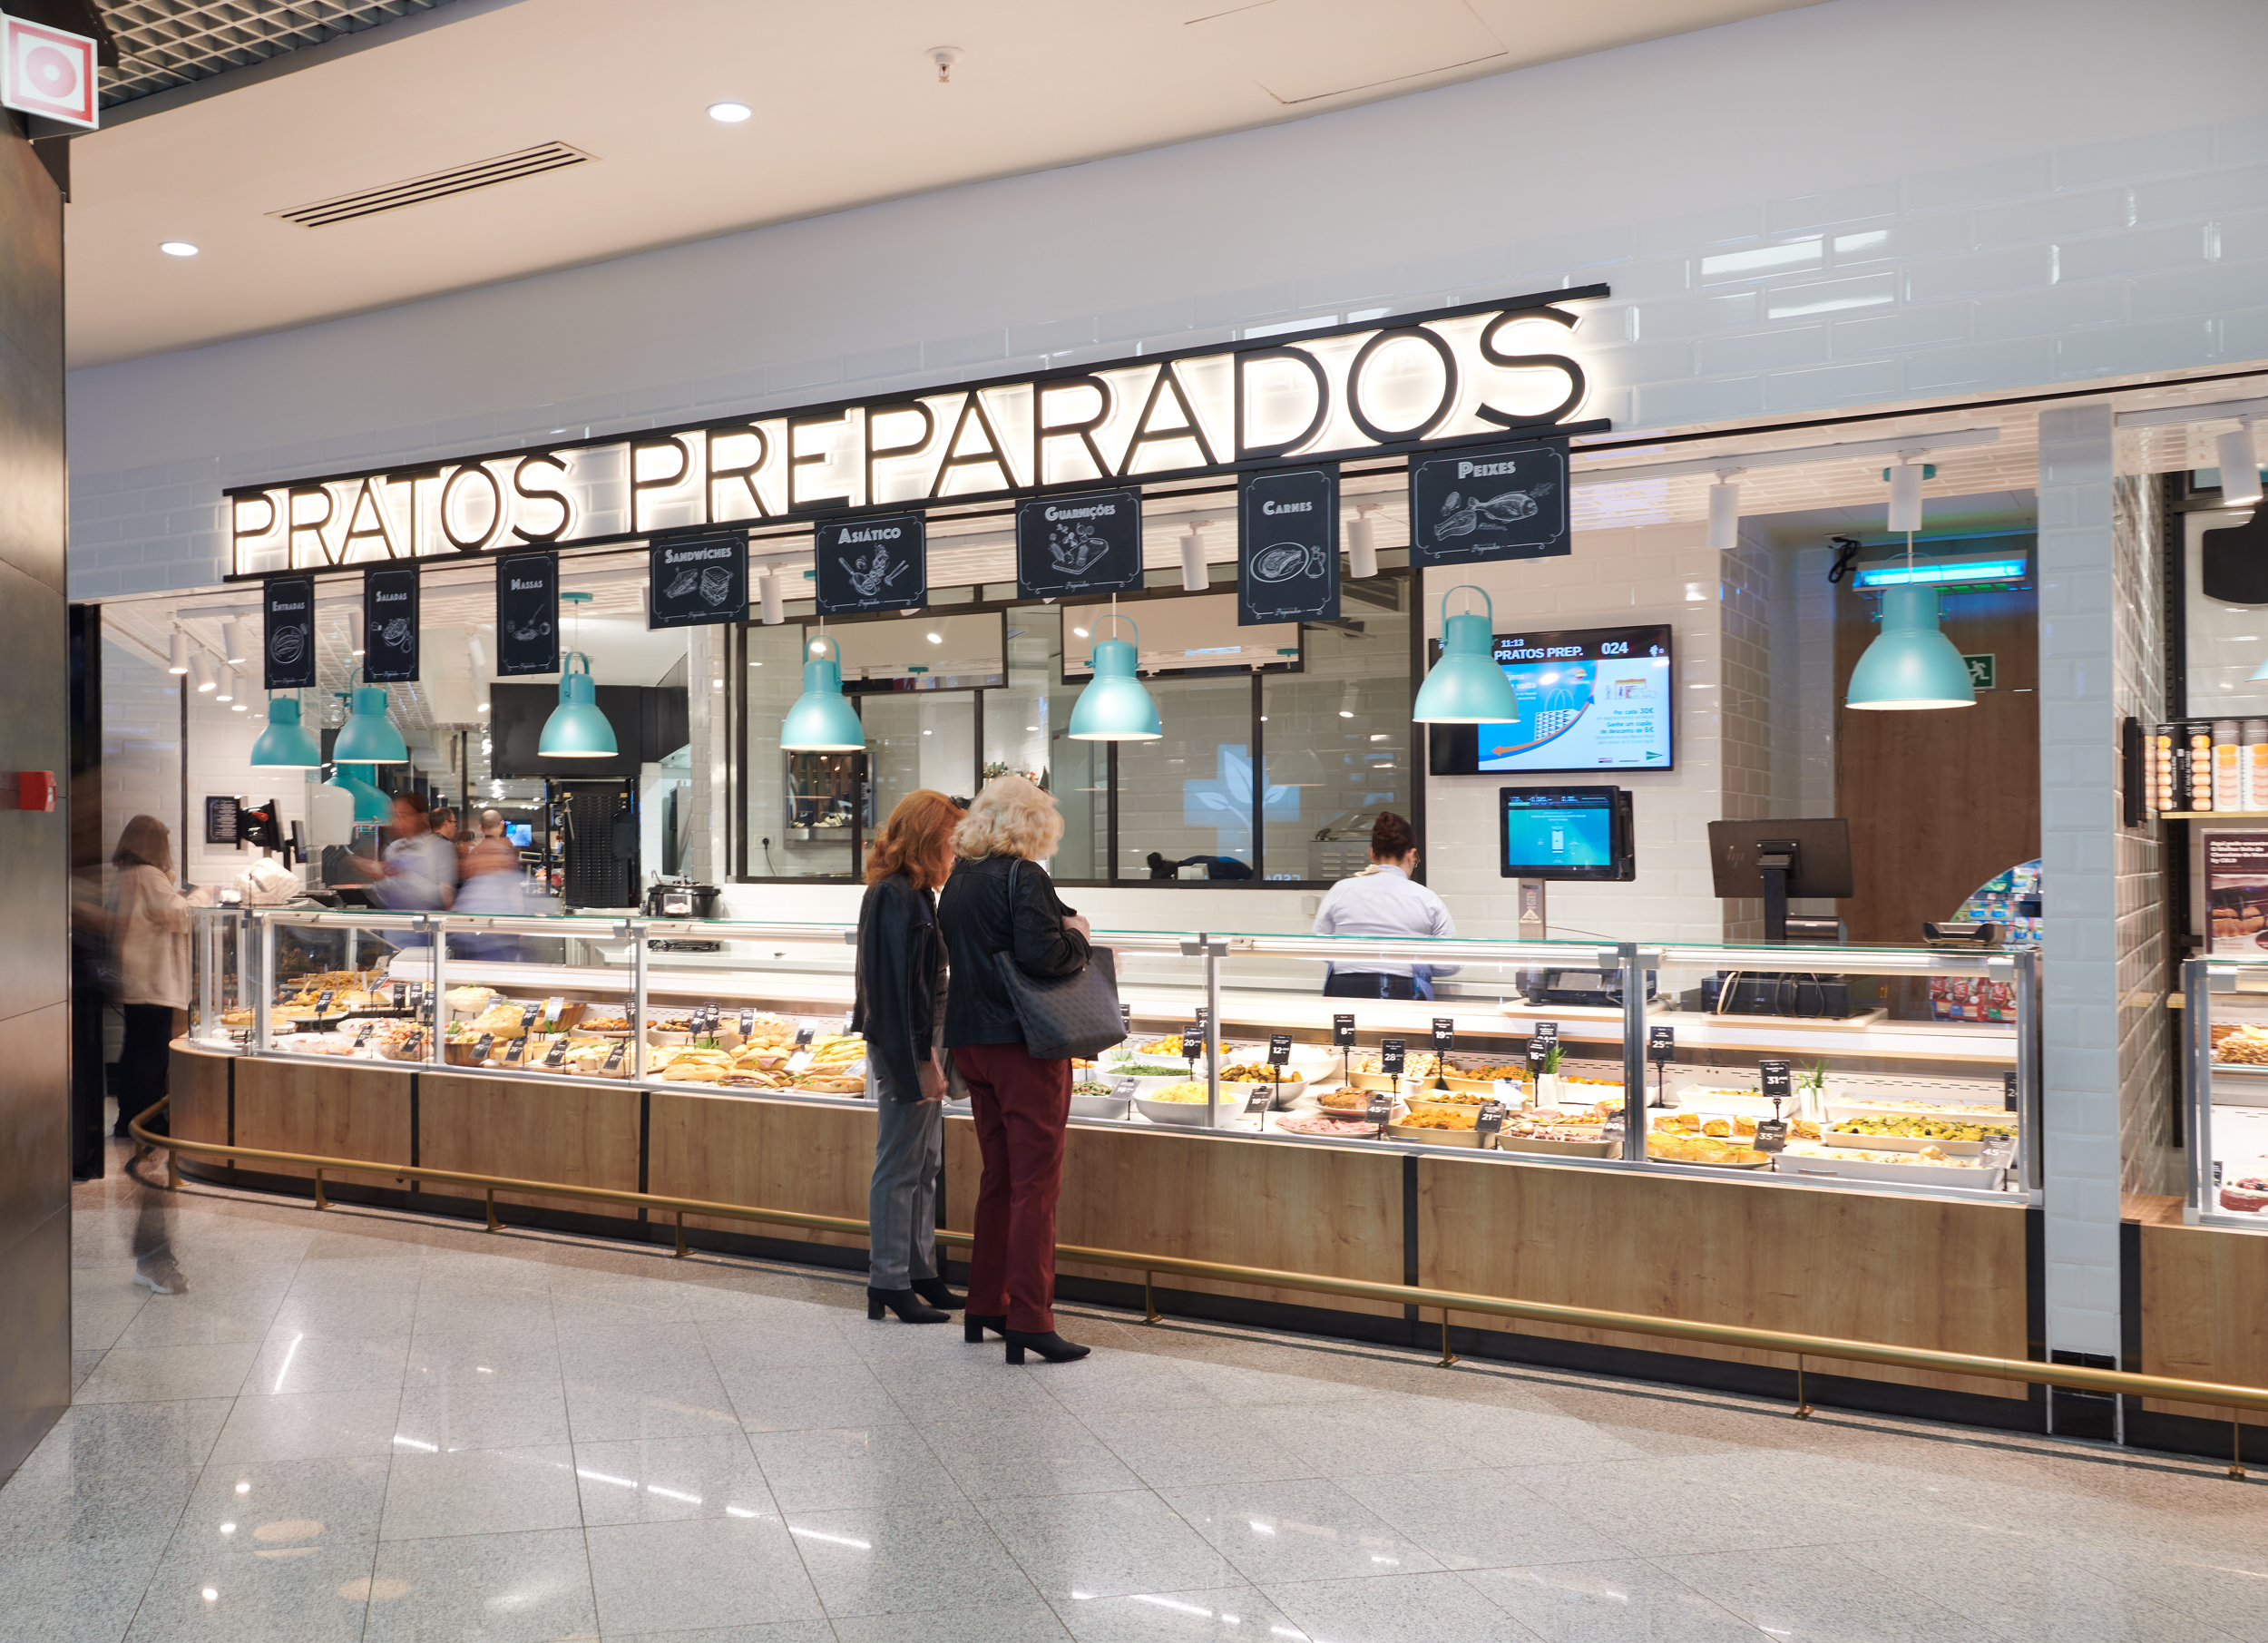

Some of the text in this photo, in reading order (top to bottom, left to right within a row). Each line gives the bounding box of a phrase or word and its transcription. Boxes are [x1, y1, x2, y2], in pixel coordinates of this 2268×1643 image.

[233, 305, 1586, 576] PRATOS PREPARADOS
[1501, 639, 1524, 648] 11:13
[1600, 641, 1629, 655] 024
[1493, 646, 1584, 660] PRATOS PREP.
